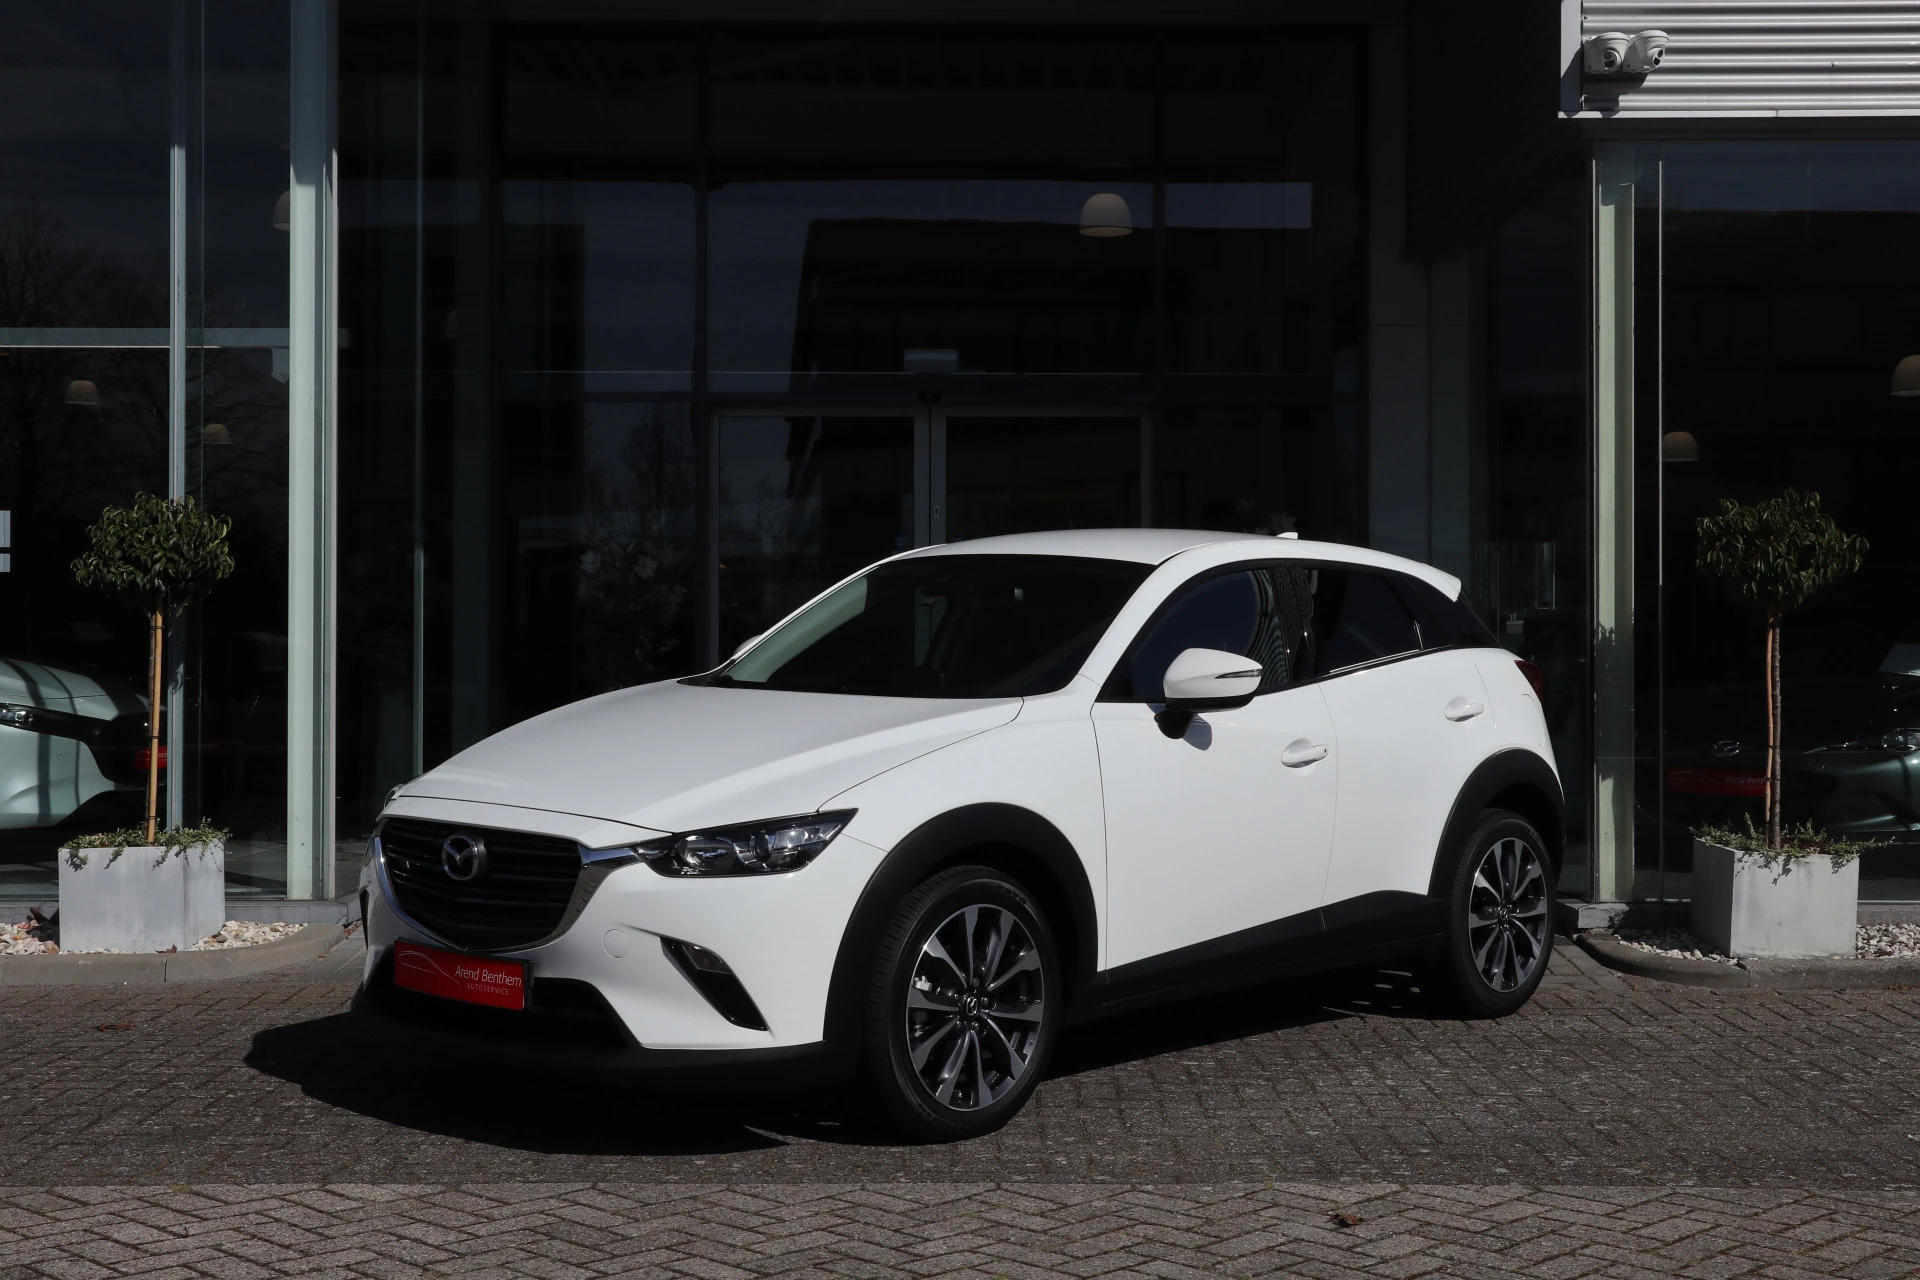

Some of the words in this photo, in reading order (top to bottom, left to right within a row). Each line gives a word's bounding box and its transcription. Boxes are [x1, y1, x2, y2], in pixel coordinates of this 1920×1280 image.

[454, 965, 480, 981] Arend
[481, 969, 522, 987] Benthem
[466, 982, 510, 996] AUTOSERVICE
